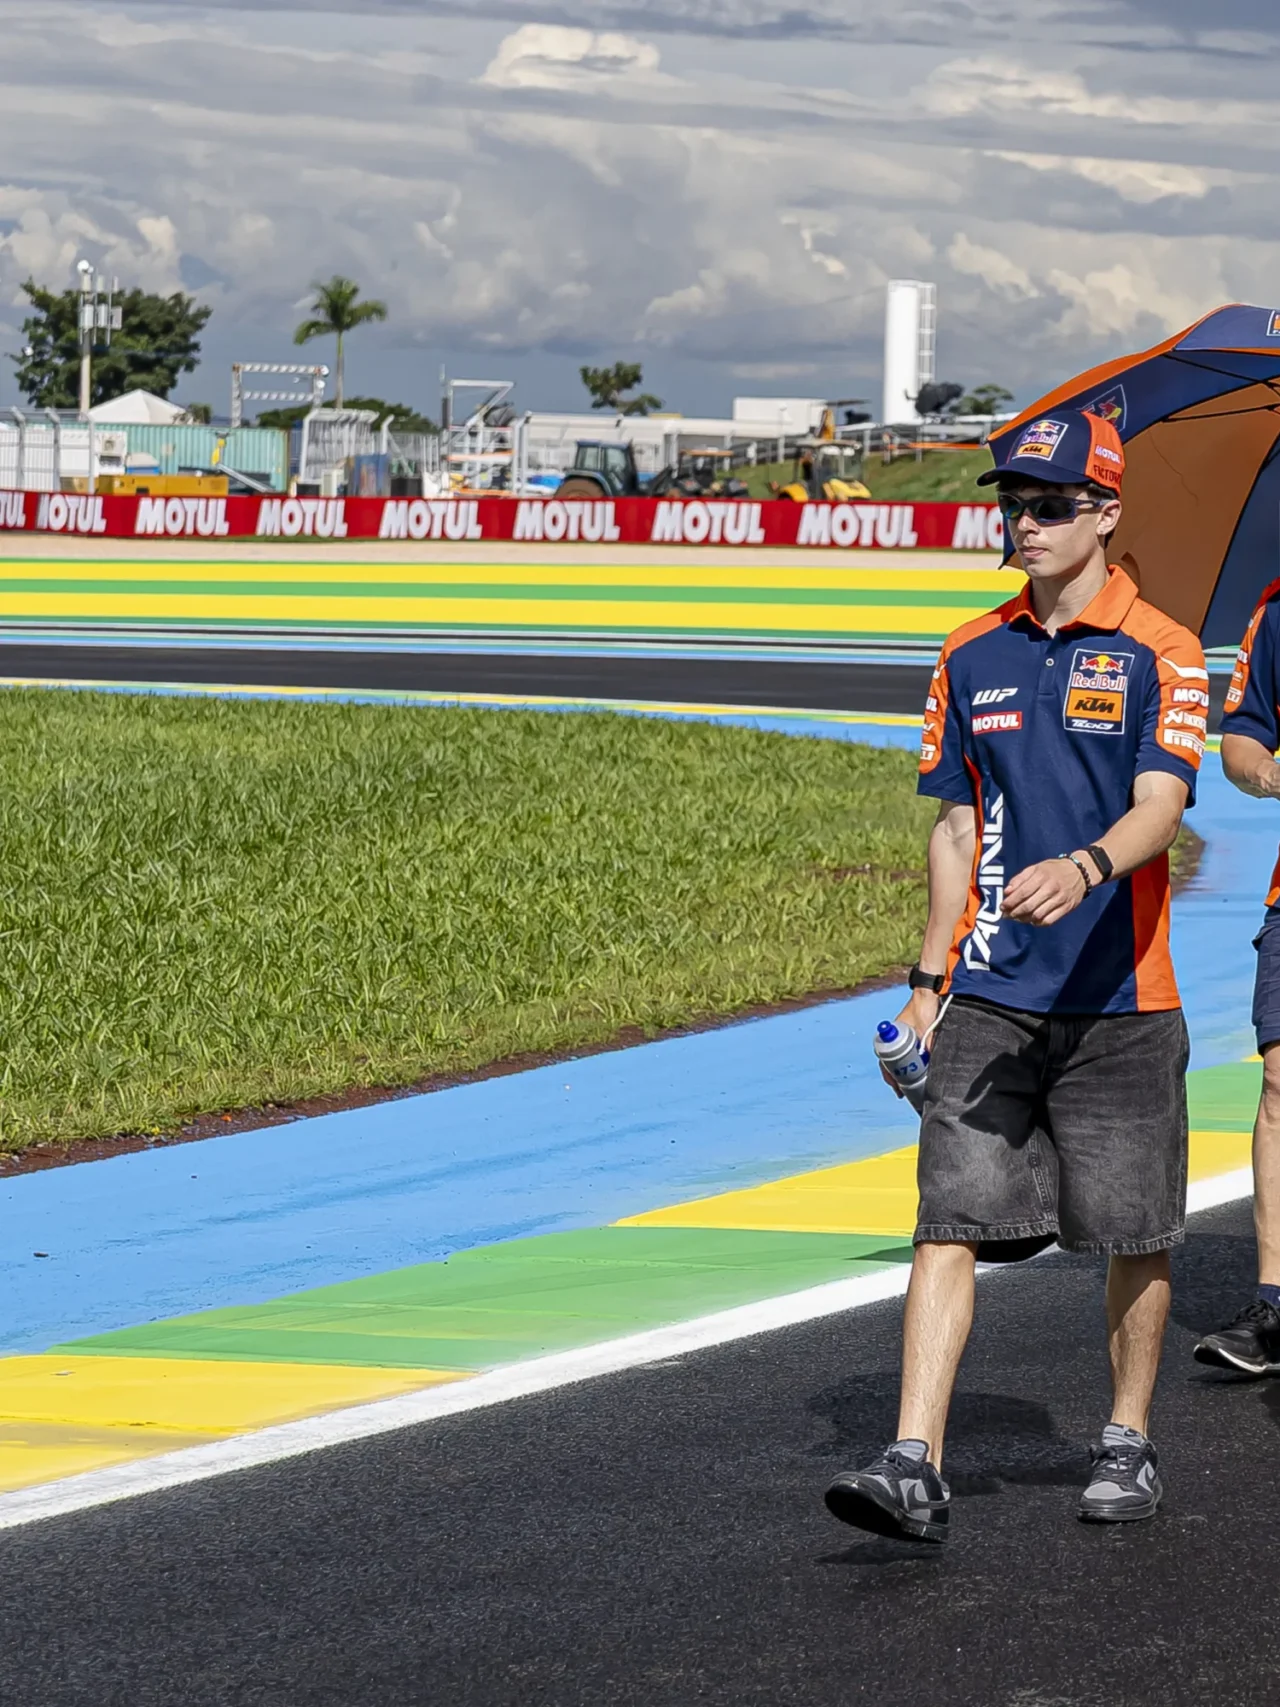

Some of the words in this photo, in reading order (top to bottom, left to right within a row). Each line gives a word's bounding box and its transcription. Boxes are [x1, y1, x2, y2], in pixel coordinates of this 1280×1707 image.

[134, 496, 230, 536] MOTUL
[255, 498, 349, 538] MOTUL
[378, 499, 483, 540] MOTUL
[513, 500, 621, 543] MOTUL
[651, 500, 766, 545] MOTUL
[796, 503, 918, 547] MOTUL
[971, 687, 1019, 706] WP
[1071, 672, 1100, 689] Red
[1099, 674, 1128, 692] Bull
[972, 713, 1020, 733] MOTUL
[1074, 697, 1116, 714] KTM
